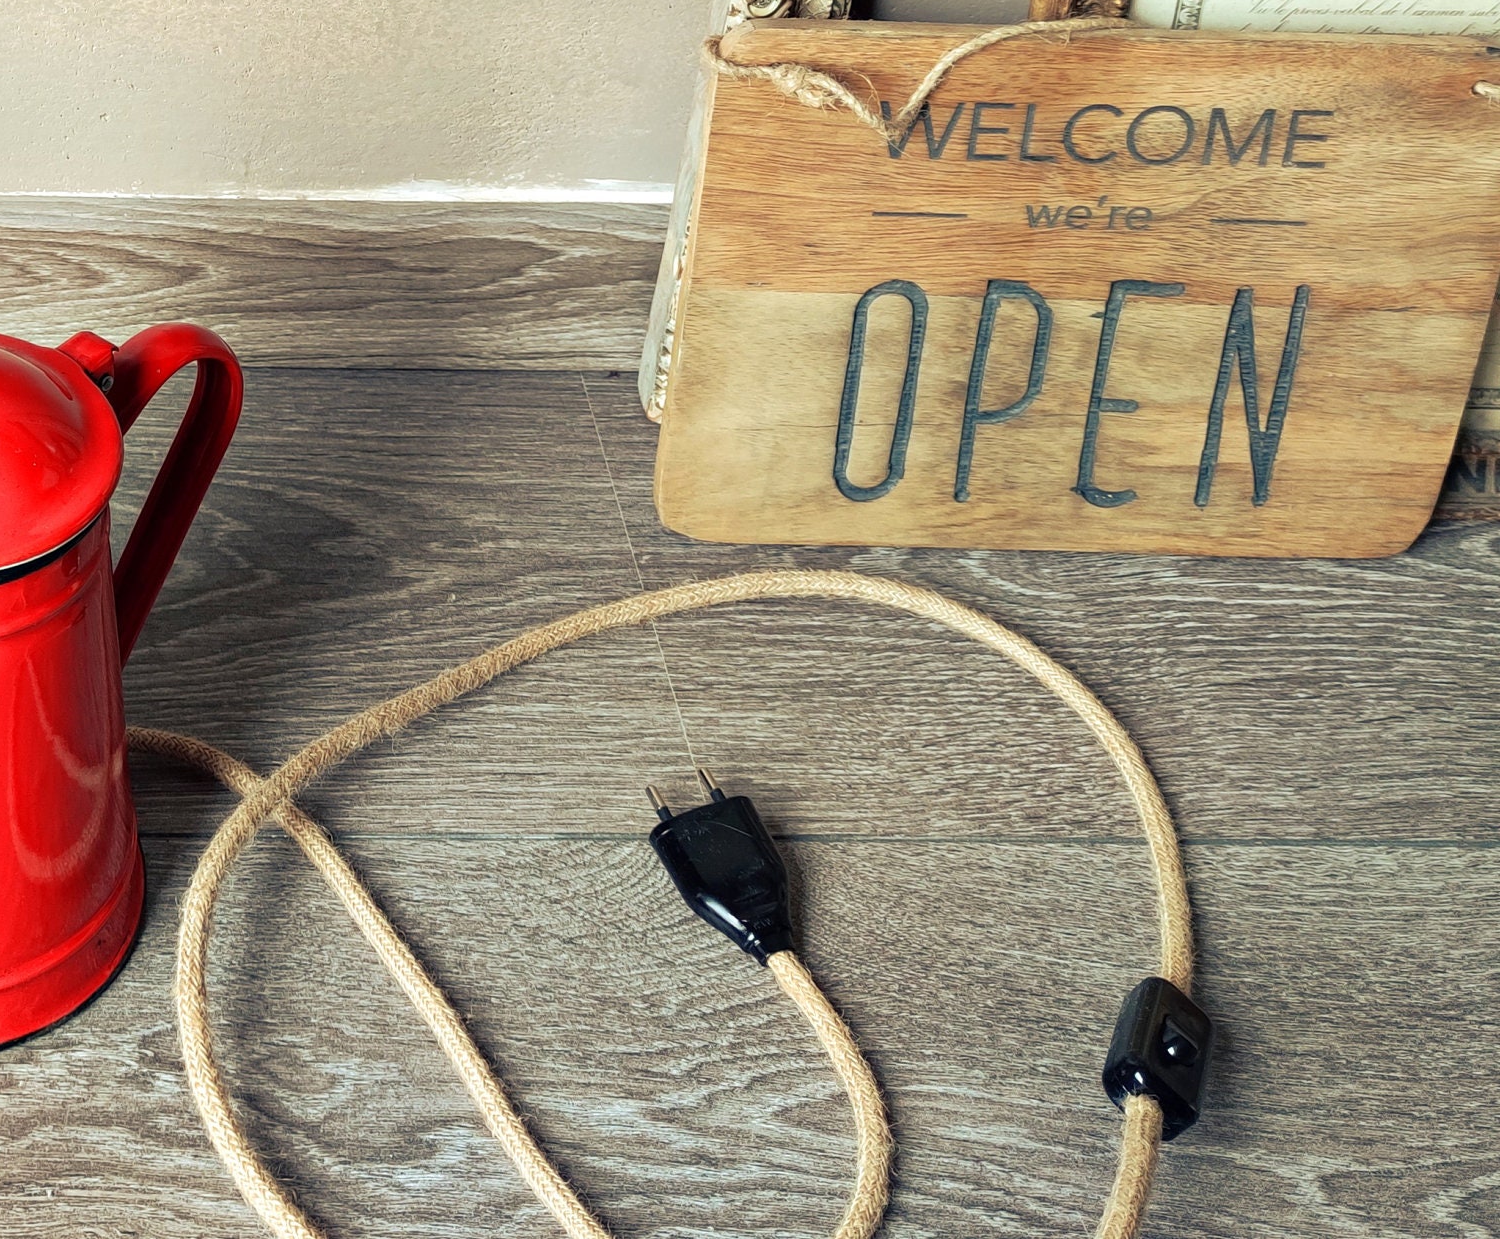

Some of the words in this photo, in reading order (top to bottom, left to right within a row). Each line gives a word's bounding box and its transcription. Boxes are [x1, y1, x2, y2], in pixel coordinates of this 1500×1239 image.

[880, 100, 1334, 169] WELCOME
[1025, 195, 1153, 230] we're
[833, 279, 1311, 508] OPEN
